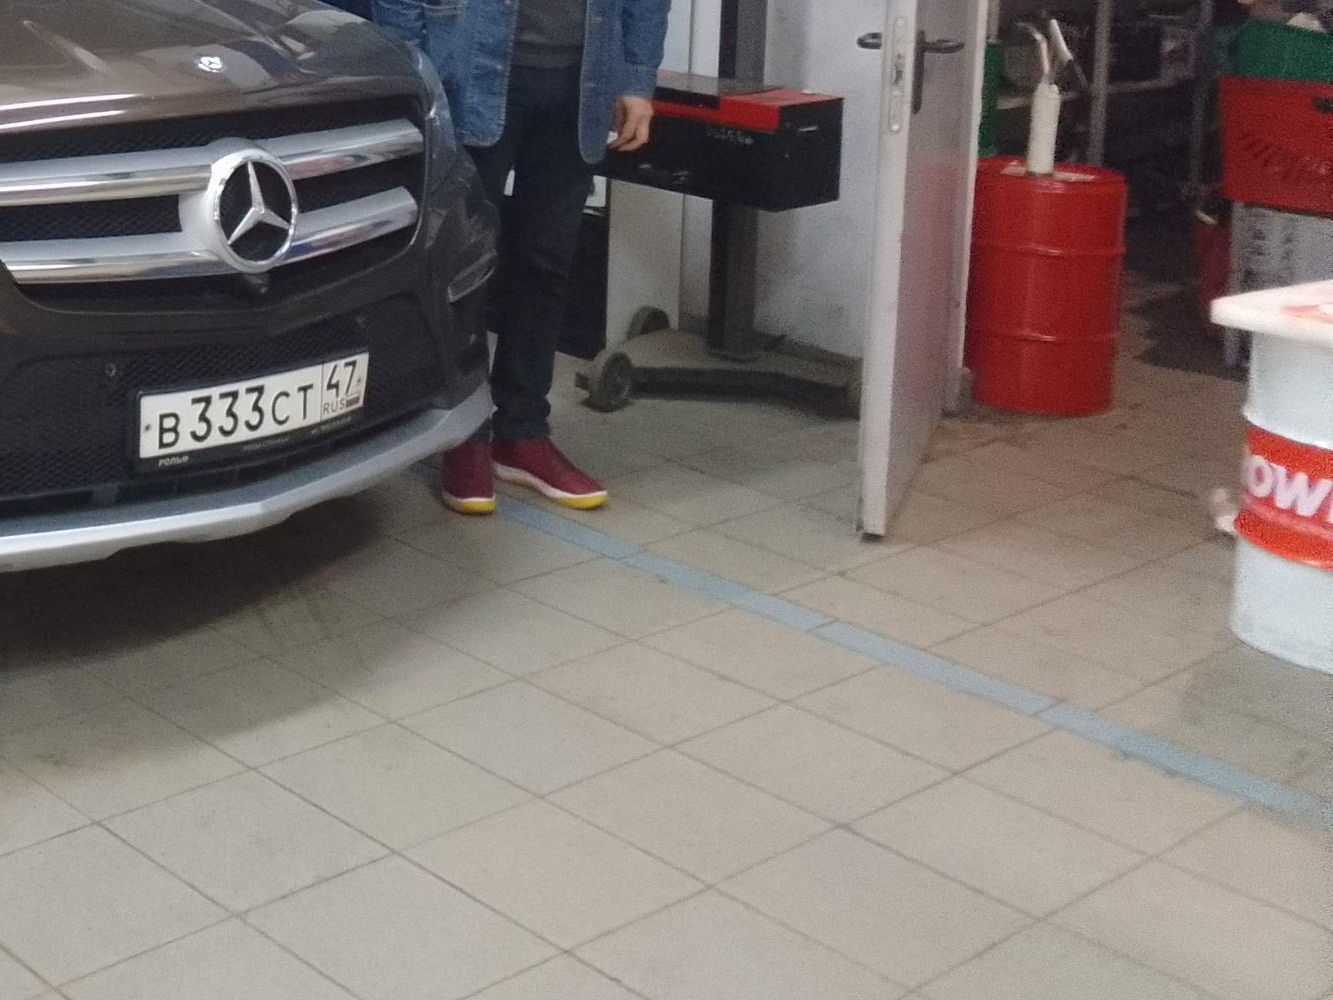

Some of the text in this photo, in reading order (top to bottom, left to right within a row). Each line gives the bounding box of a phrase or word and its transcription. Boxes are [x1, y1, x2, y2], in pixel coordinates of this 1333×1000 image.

[326, 360, 357, 399] 47
[322, 397, 345, 415] RUS
[1243, 454, 1333, 525] OW
